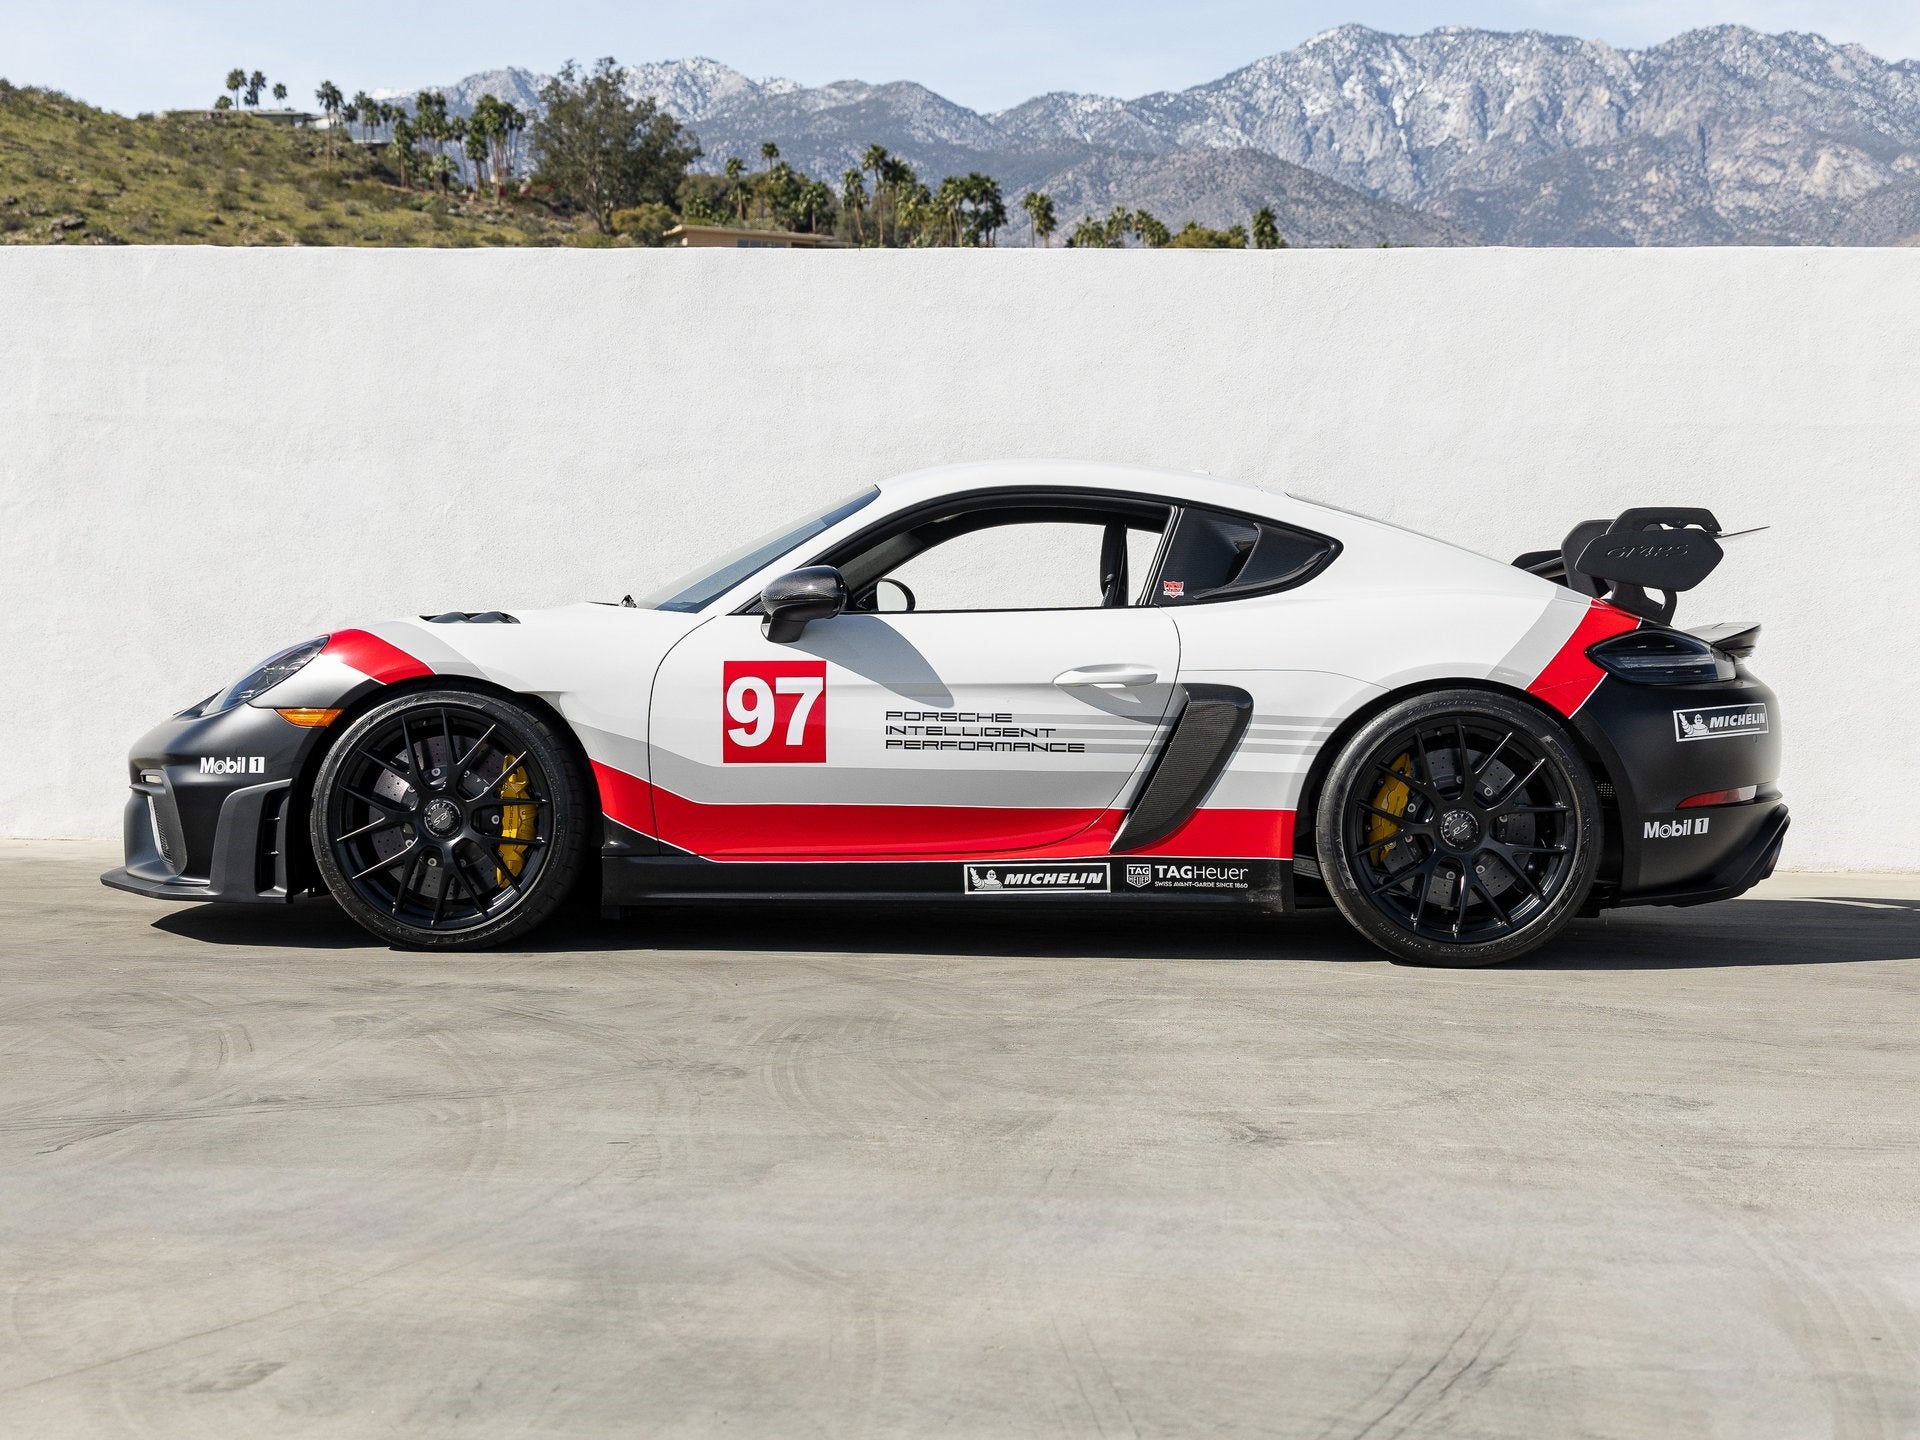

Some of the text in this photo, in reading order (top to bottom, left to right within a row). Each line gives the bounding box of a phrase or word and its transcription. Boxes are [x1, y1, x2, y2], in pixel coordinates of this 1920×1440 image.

[726, 675, 824, 748] 97
[885, 711, 1013, 723] PORSCHE
[1709, 712, 1766, 729] MICHELIN
[885, 725, 1057, 738] INTELLIGENT
[885, 739, 1085, 753] PERFORMANCE
[200, 756, 246, 775] Mobil
[1453, 821, 1468, 836] RS
[1643, 818, 1692, 839] Mobil
[1128, 866, 1150, 876] TAG
[1003, 872, 1104, 886] MICHELIN
